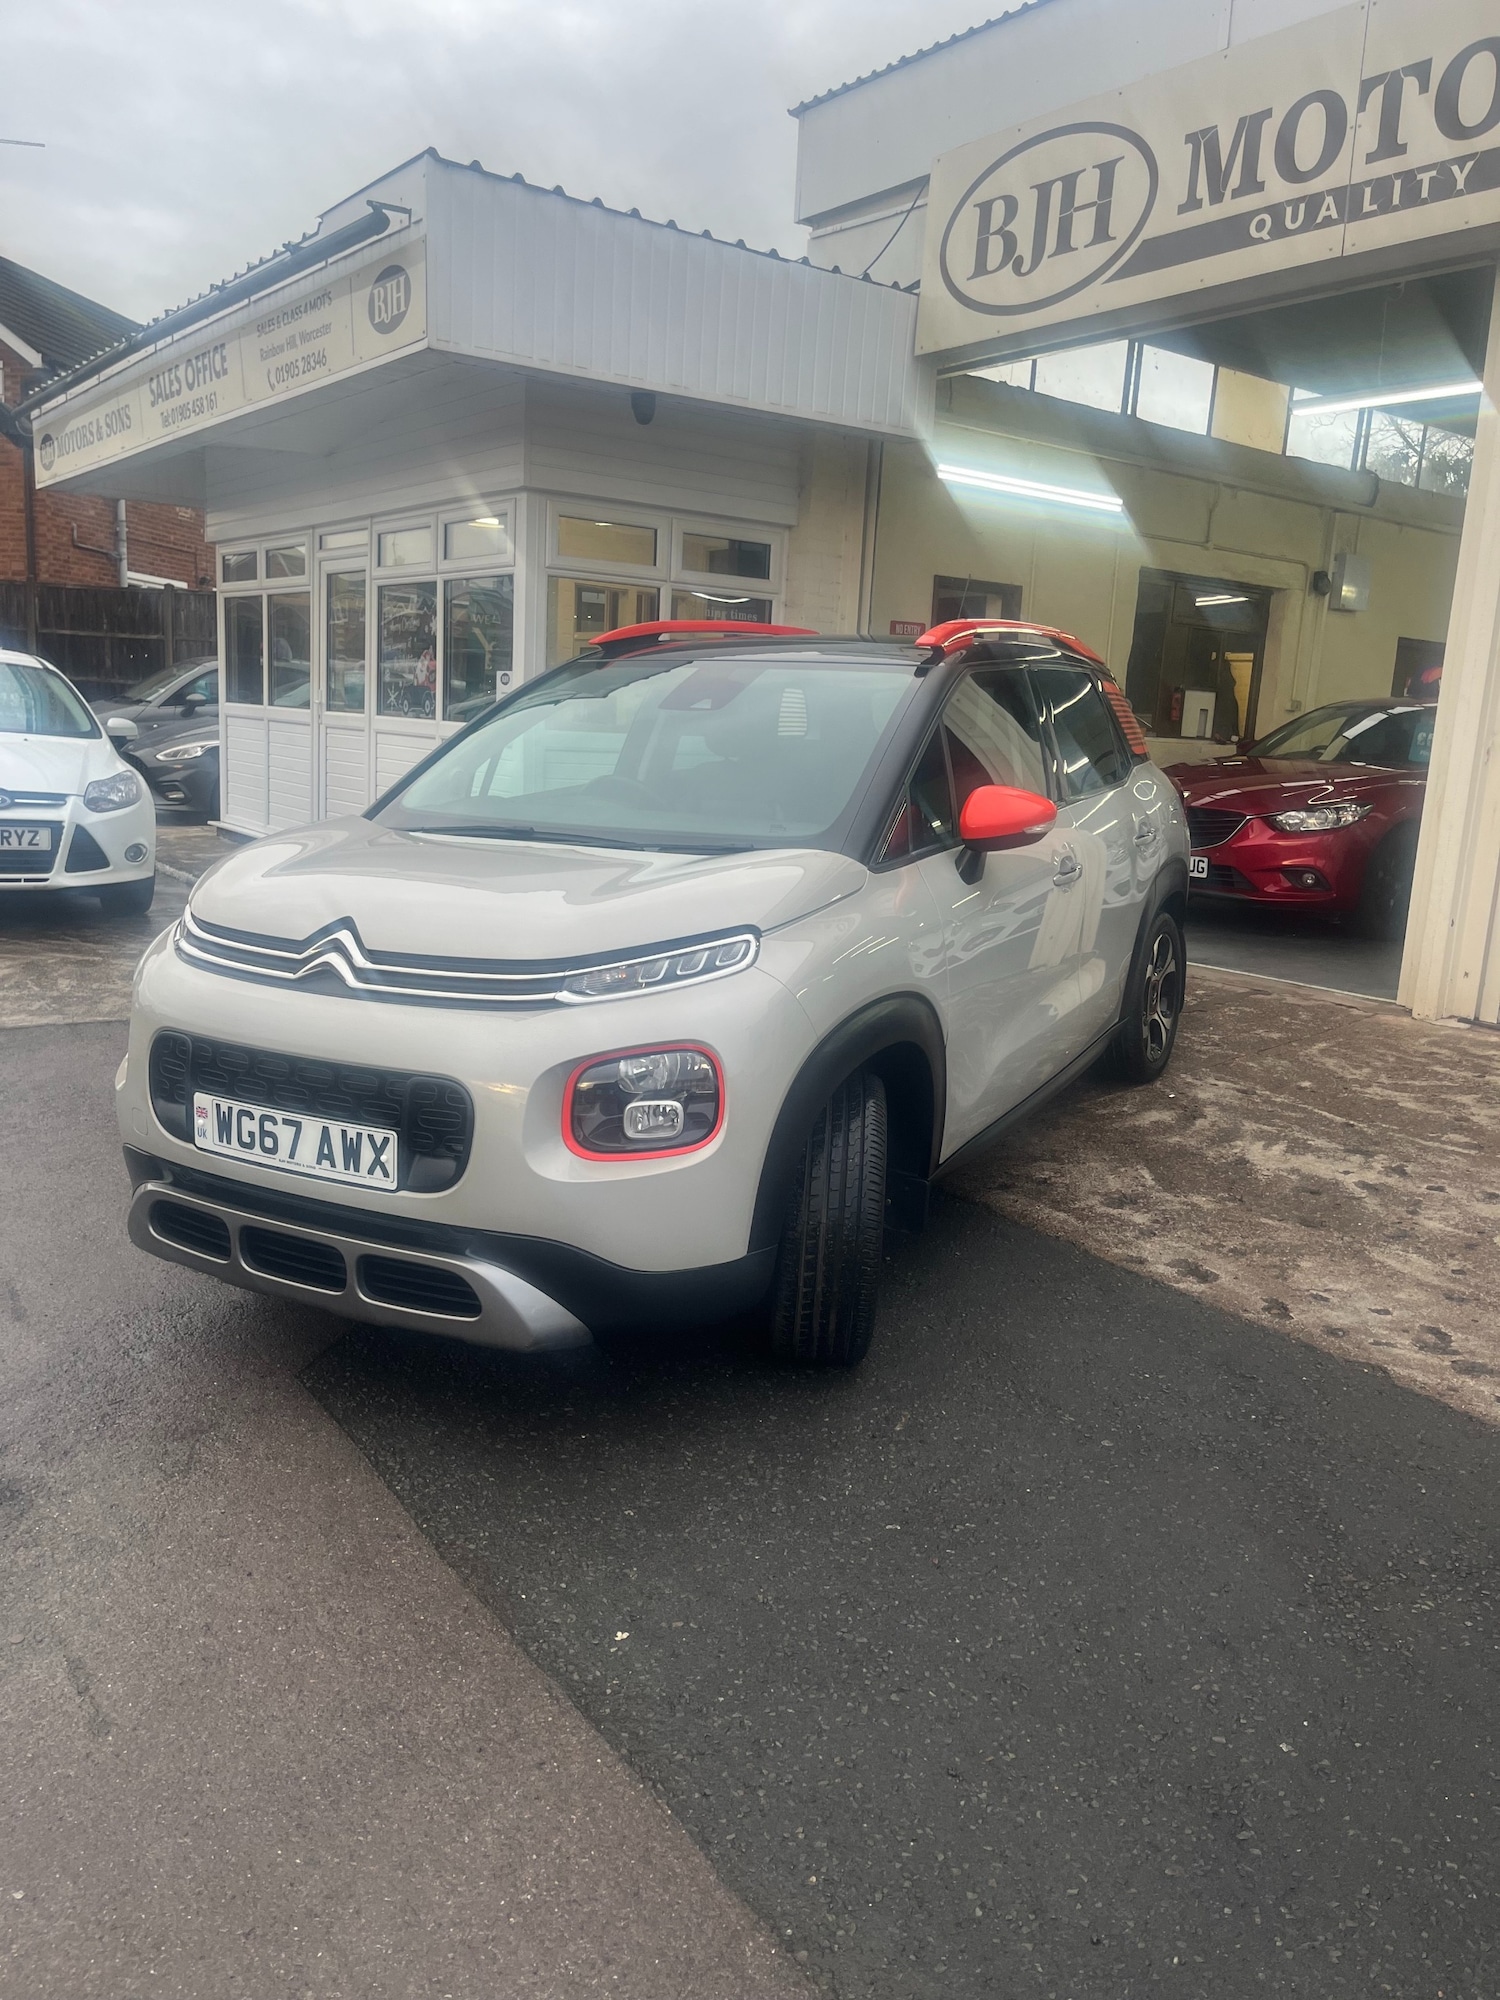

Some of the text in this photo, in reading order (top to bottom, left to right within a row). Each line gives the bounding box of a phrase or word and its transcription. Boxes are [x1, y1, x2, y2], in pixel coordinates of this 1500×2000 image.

[967, 36, 1500, 281] BJH MOTO
[1248, 160, 1477, 241] QUALITY
[372, 274, 407, 324] BJH
[257, 317, 276, 338] SALES
[282, 305, 302, 326] CLASS
[303, 302, 308, 314] 4
[260, 343, 285, 362] Rainbow
[298, 322, 332, 346] Worcester
[149, 342, 228, 408] SALES OFFICE
[275, 347, 327, 385] 01905 28346
[192, 396, 205, 417] 458
[205, 391, 218, 412] 161
[56, 421, 95, 459] MOTORS
[95, 420, 104, 442] &
[105, 404, 132, 438] SONS
[730, 609, 758, 622] times
[895, 623, 921, 636] NO ENTRY
[0, 829, 40, 847] RYZ
[197, 1127, 208, 1140] UK
[215, 1103, 391, 1179] WG67 AWX
